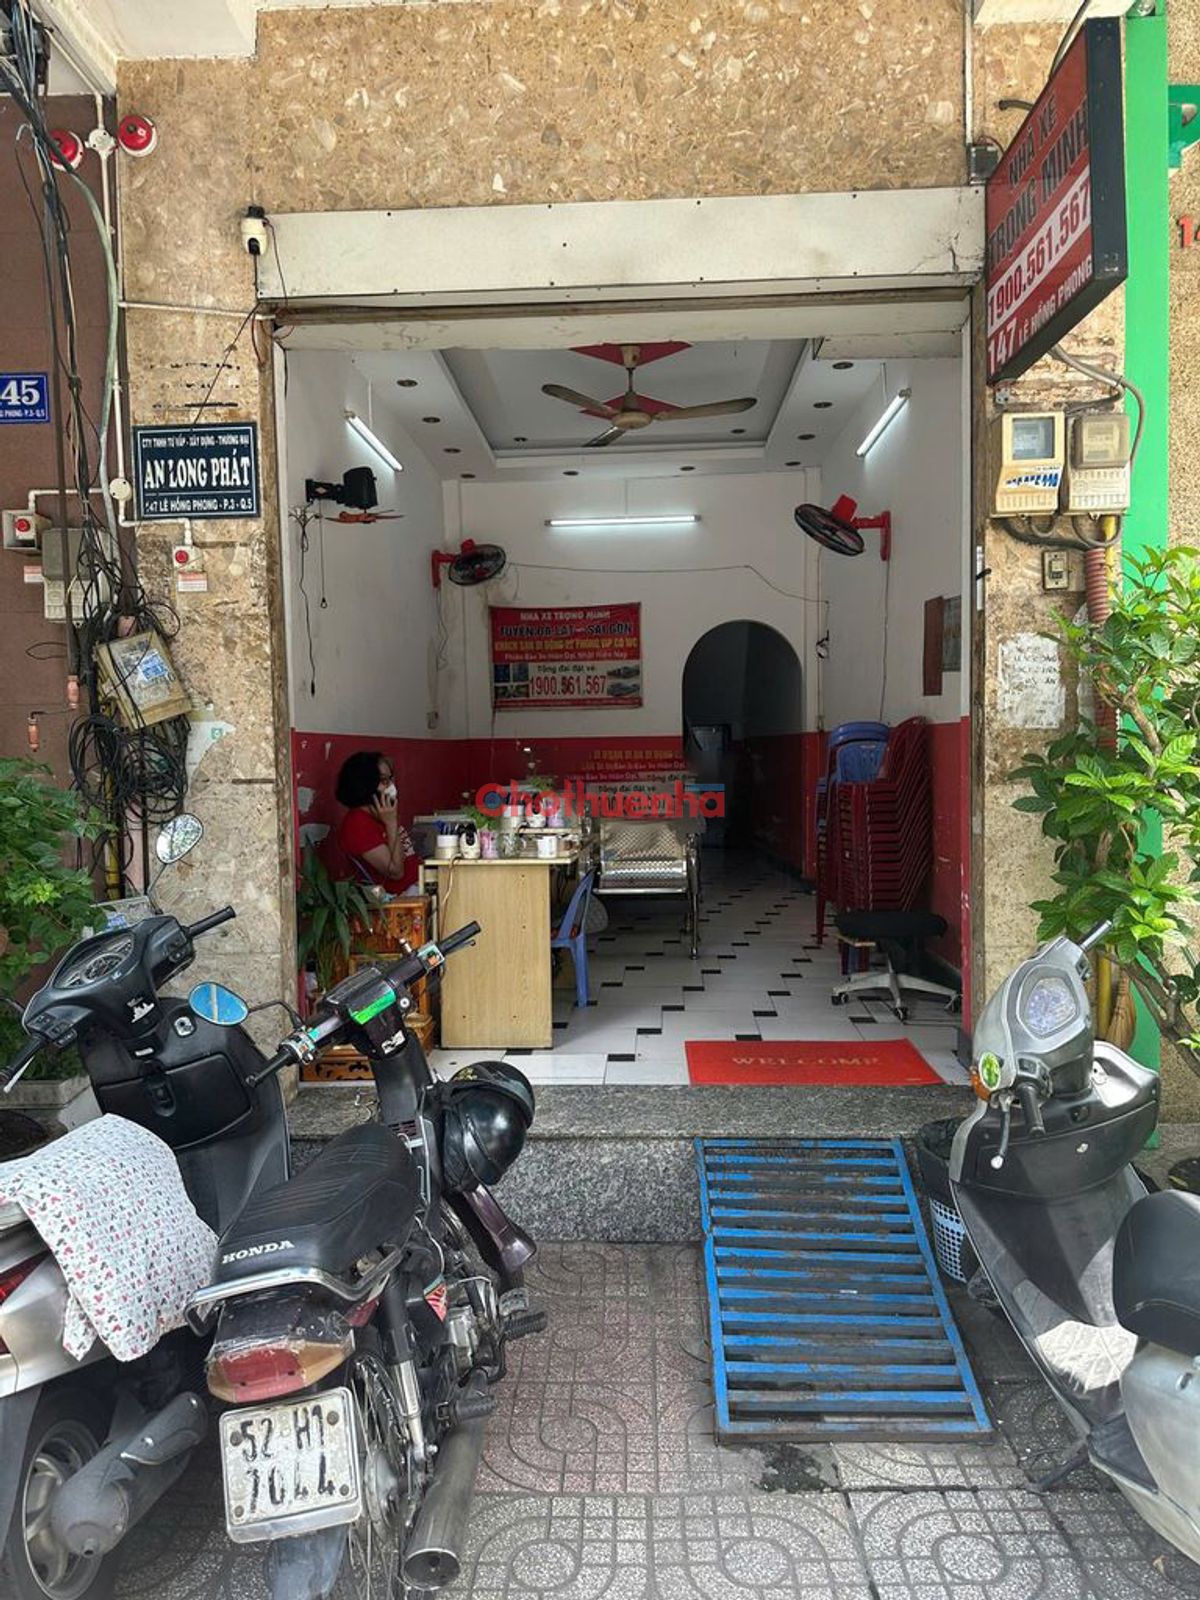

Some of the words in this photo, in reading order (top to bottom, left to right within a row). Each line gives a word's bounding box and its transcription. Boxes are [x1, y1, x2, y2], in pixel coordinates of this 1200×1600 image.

[1041, 96, 1089, 203] MINH
[989, 178, 1090, 328] 1900.561.567
[989, 318, 1017, 375] 147
[1058, 254, 1093, 310] PHONG
[144, 458, 165, 489] AN
[168, 457, 208, 488] LONG
[210, 448, 250, 487] PHÁT
[160, 499, 169, 511] LÊ
[170, 496, 192, 511] HỒNG
[192, 498, 218, 511] PHONG
[223, 498, 235, 510] P.3
[240, 497, 253, 510] Q.5
[529, 675, 607, 697] 1900.561.567
[221, 1239, 295, 1265] HONDA
[240, 1418, 273, 1462] 52
[293, 1404, 325, 1450] H1
